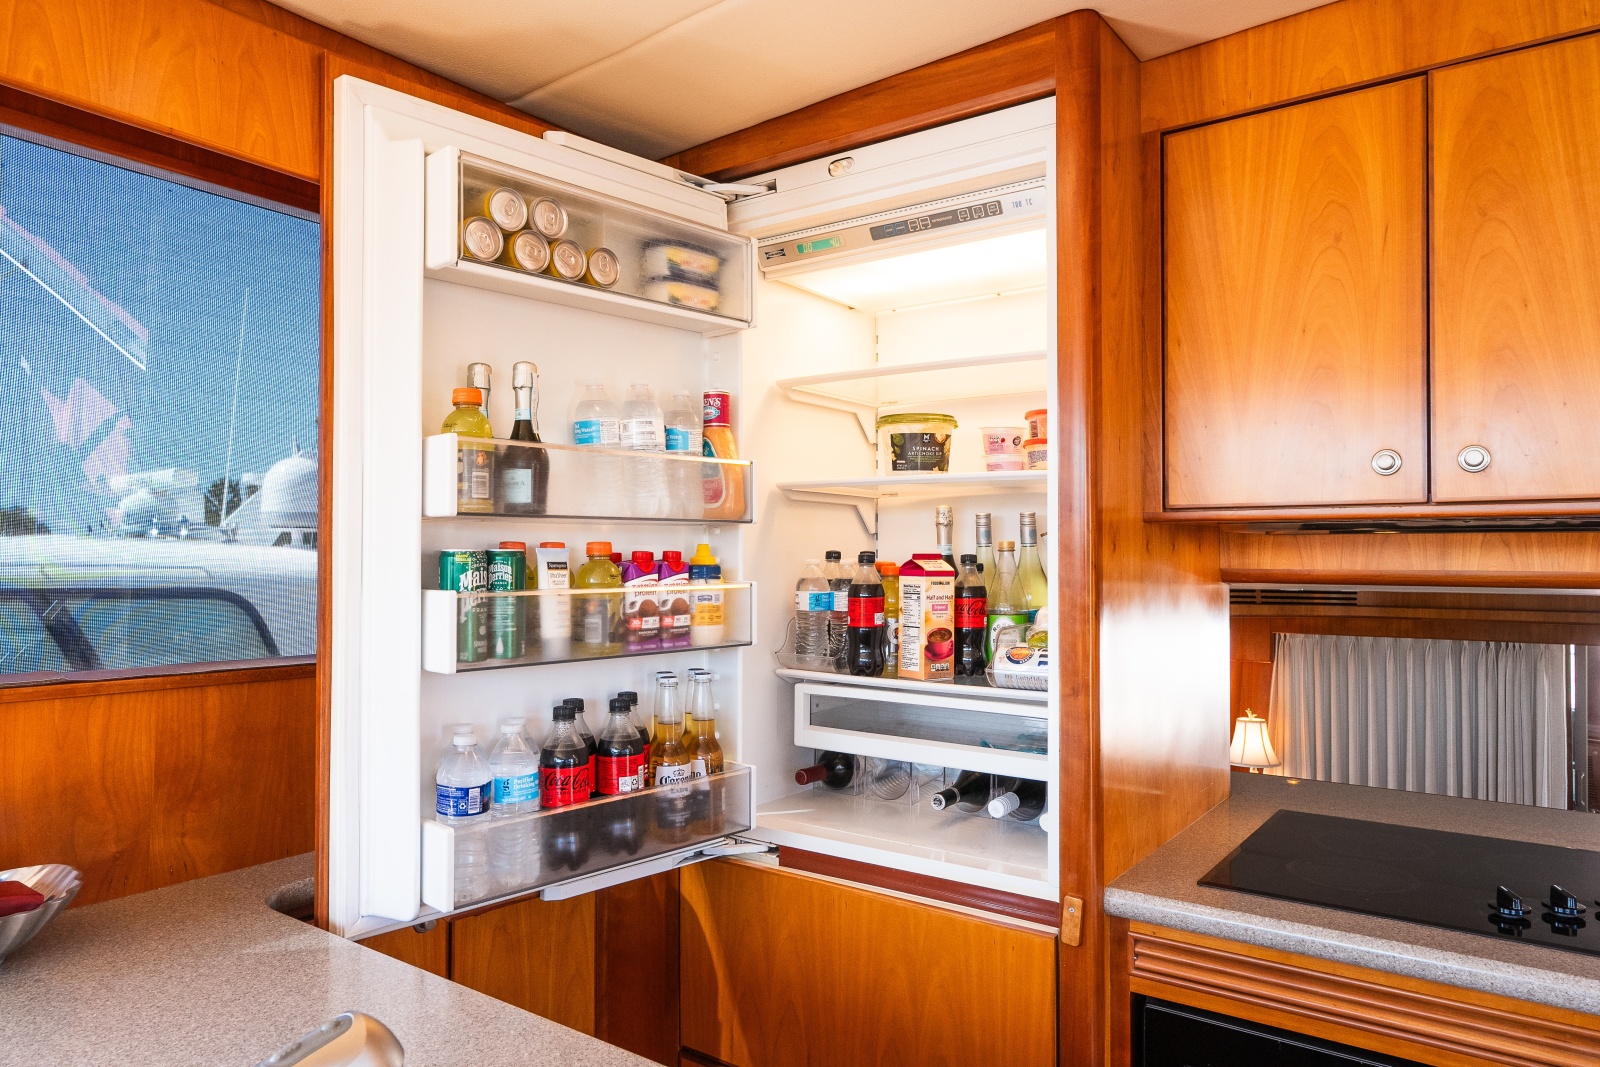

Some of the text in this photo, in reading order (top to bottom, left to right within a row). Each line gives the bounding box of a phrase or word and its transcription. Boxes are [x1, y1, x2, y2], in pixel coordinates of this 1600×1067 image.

[704, 398, 721, 408] EN'S
[459, 568, 487, 592] Mais
[514, 776, 534, 784] Purified
